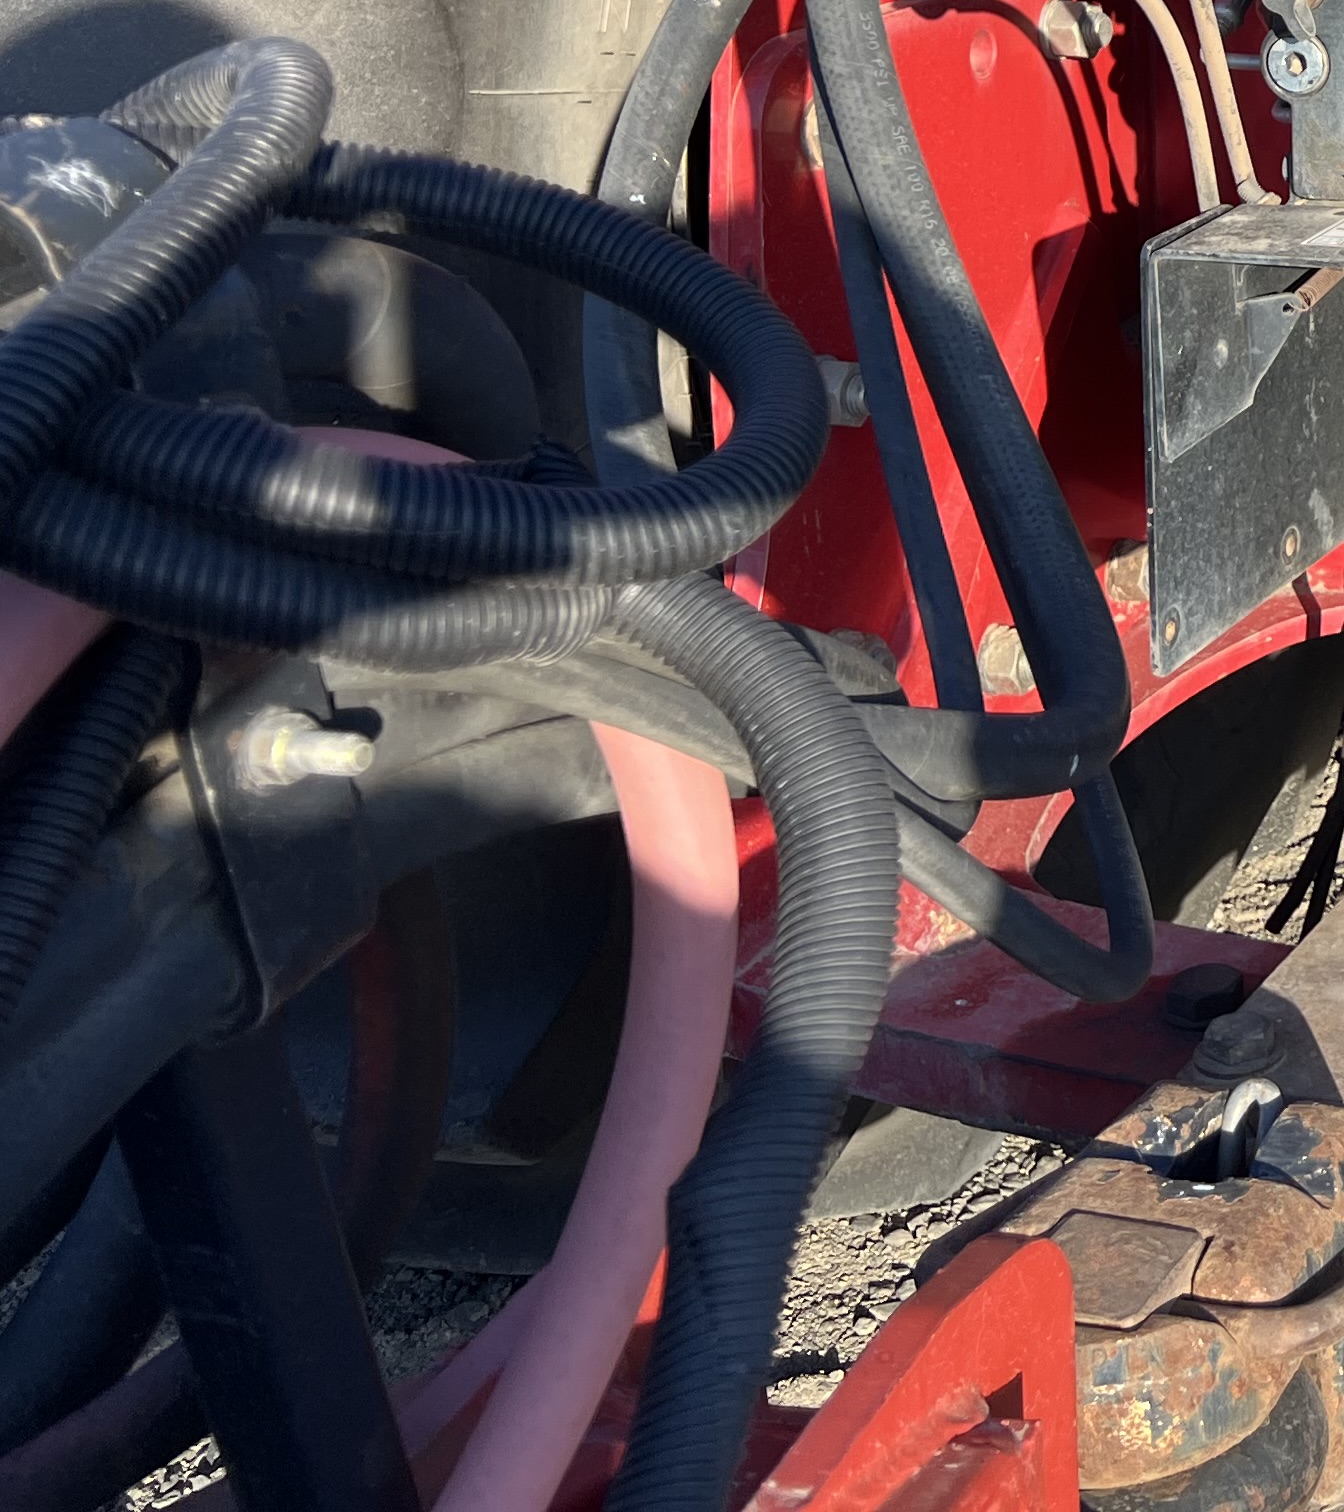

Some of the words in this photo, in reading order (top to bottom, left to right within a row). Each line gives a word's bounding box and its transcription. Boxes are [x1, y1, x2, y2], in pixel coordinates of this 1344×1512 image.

[860, 10, 880, 51] 3500
[892, 125, 912, 156] SAE
[904, 165, 924, 192] 100
